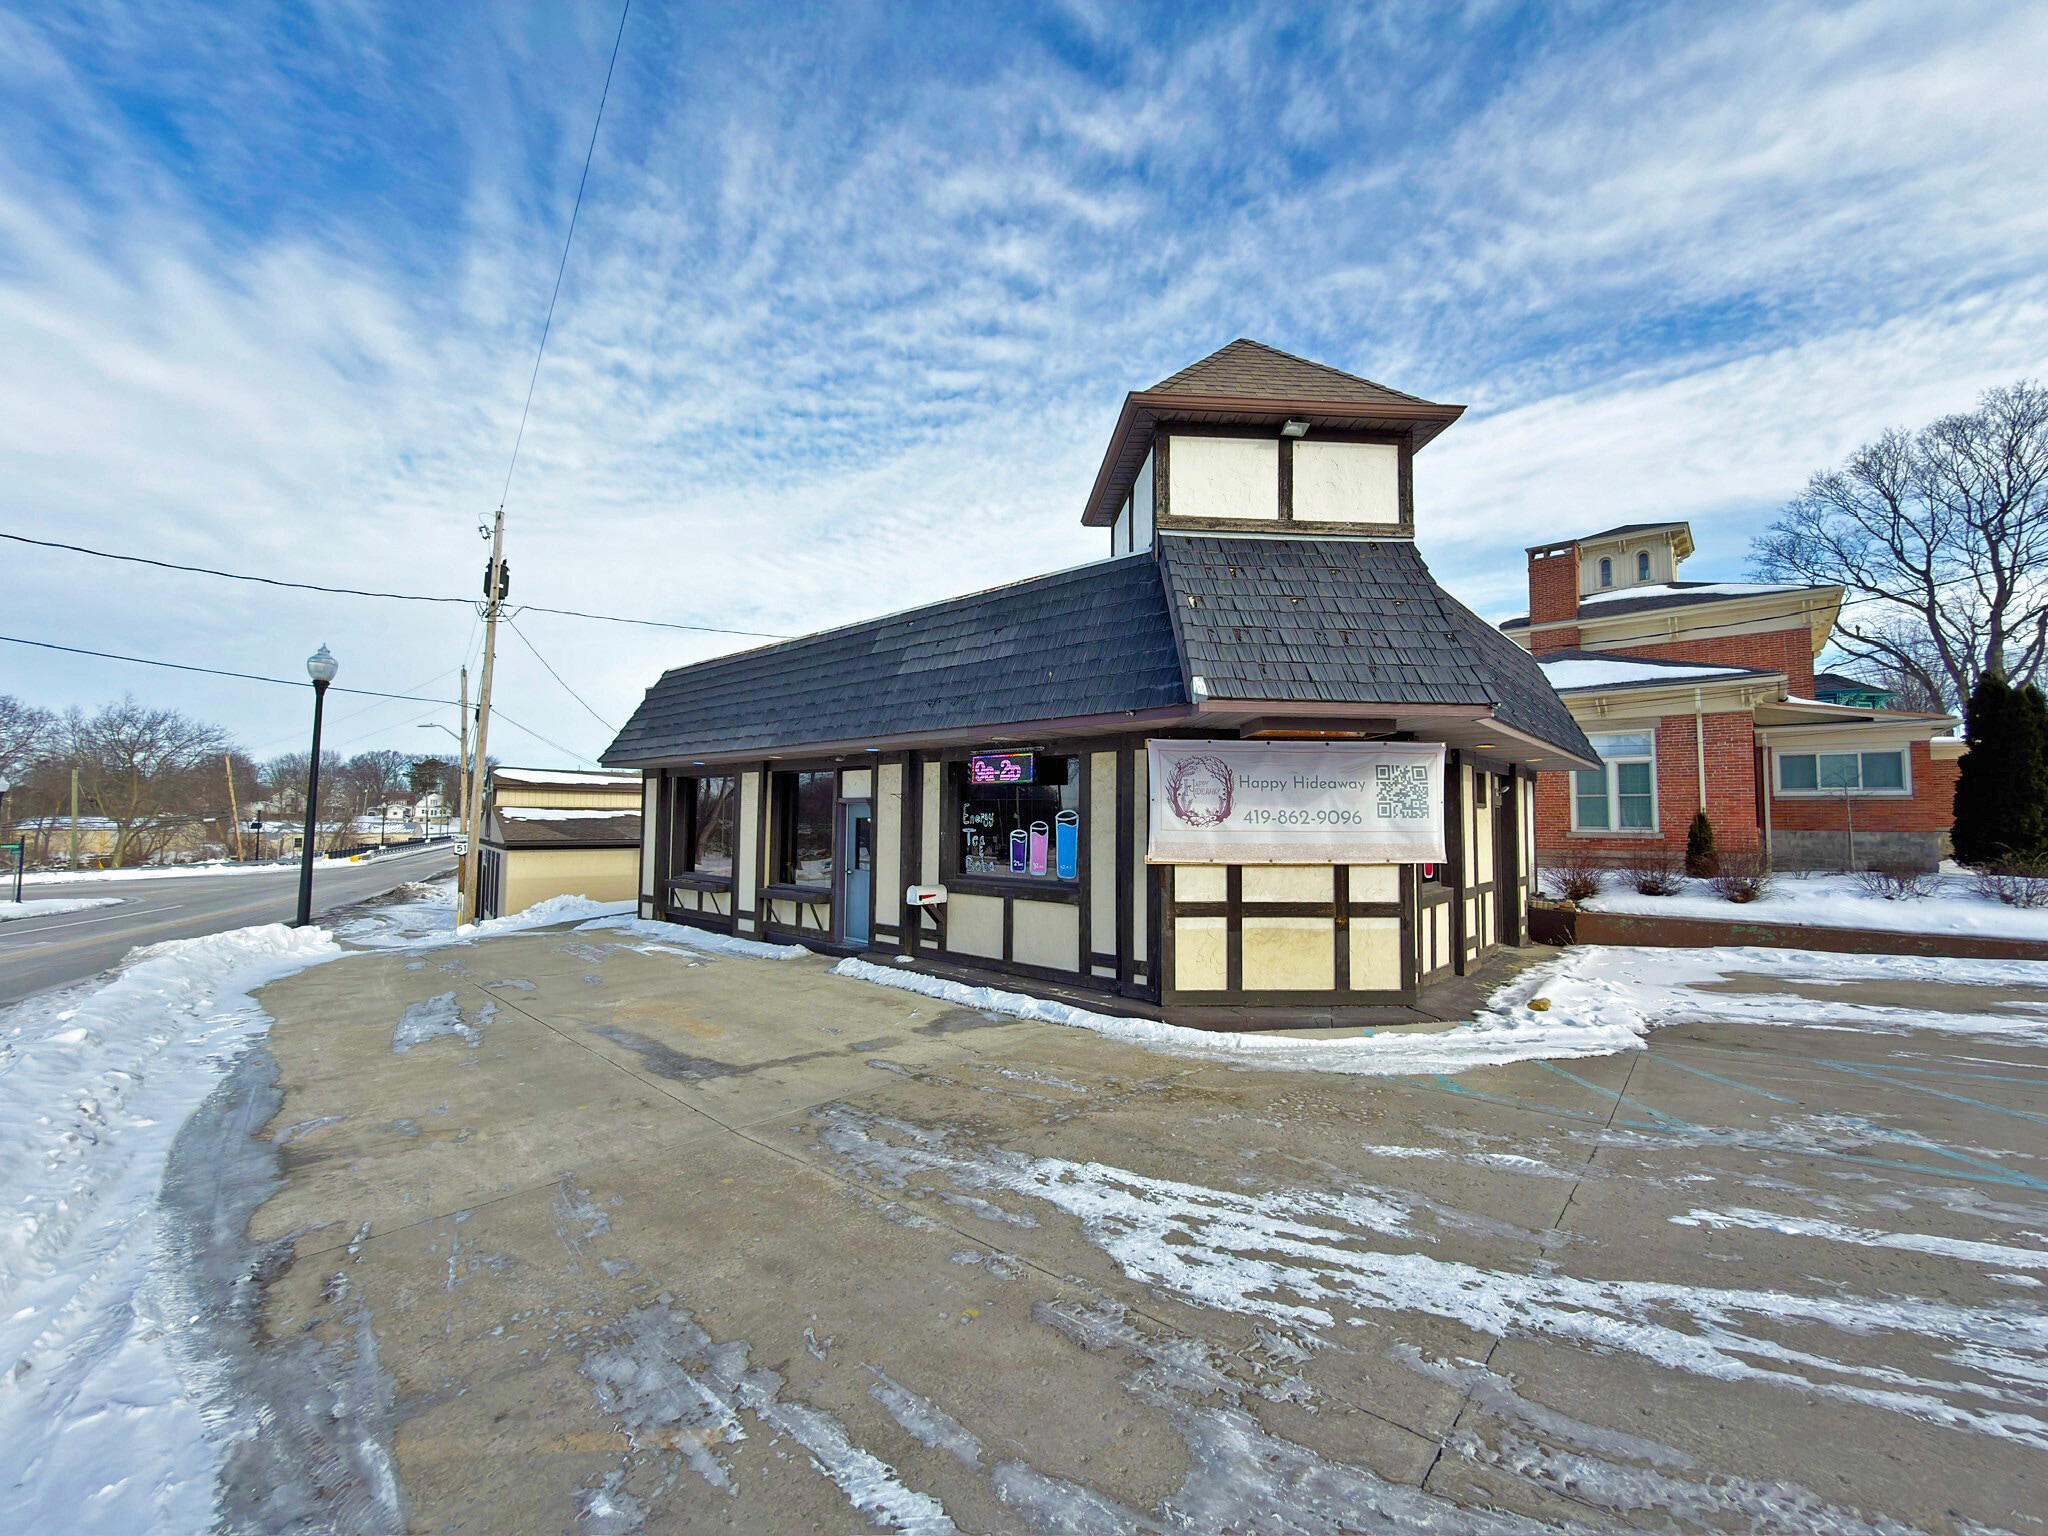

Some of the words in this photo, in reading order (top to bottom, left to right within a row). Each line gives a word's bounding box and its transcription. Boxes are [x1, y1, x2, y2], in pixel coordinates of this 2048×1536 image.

[1239, 774, 1287, 791] Happy
[1293, 775, 1366, 792] Hideaway
[963, 803, 994, 827] Energy
[1243, 810, 1363, 825] 419-862-9096
[962, 828, 985, 848] Tea
[457, 844, 467, 853] 51
[966, 855, 995, 874] Boba
